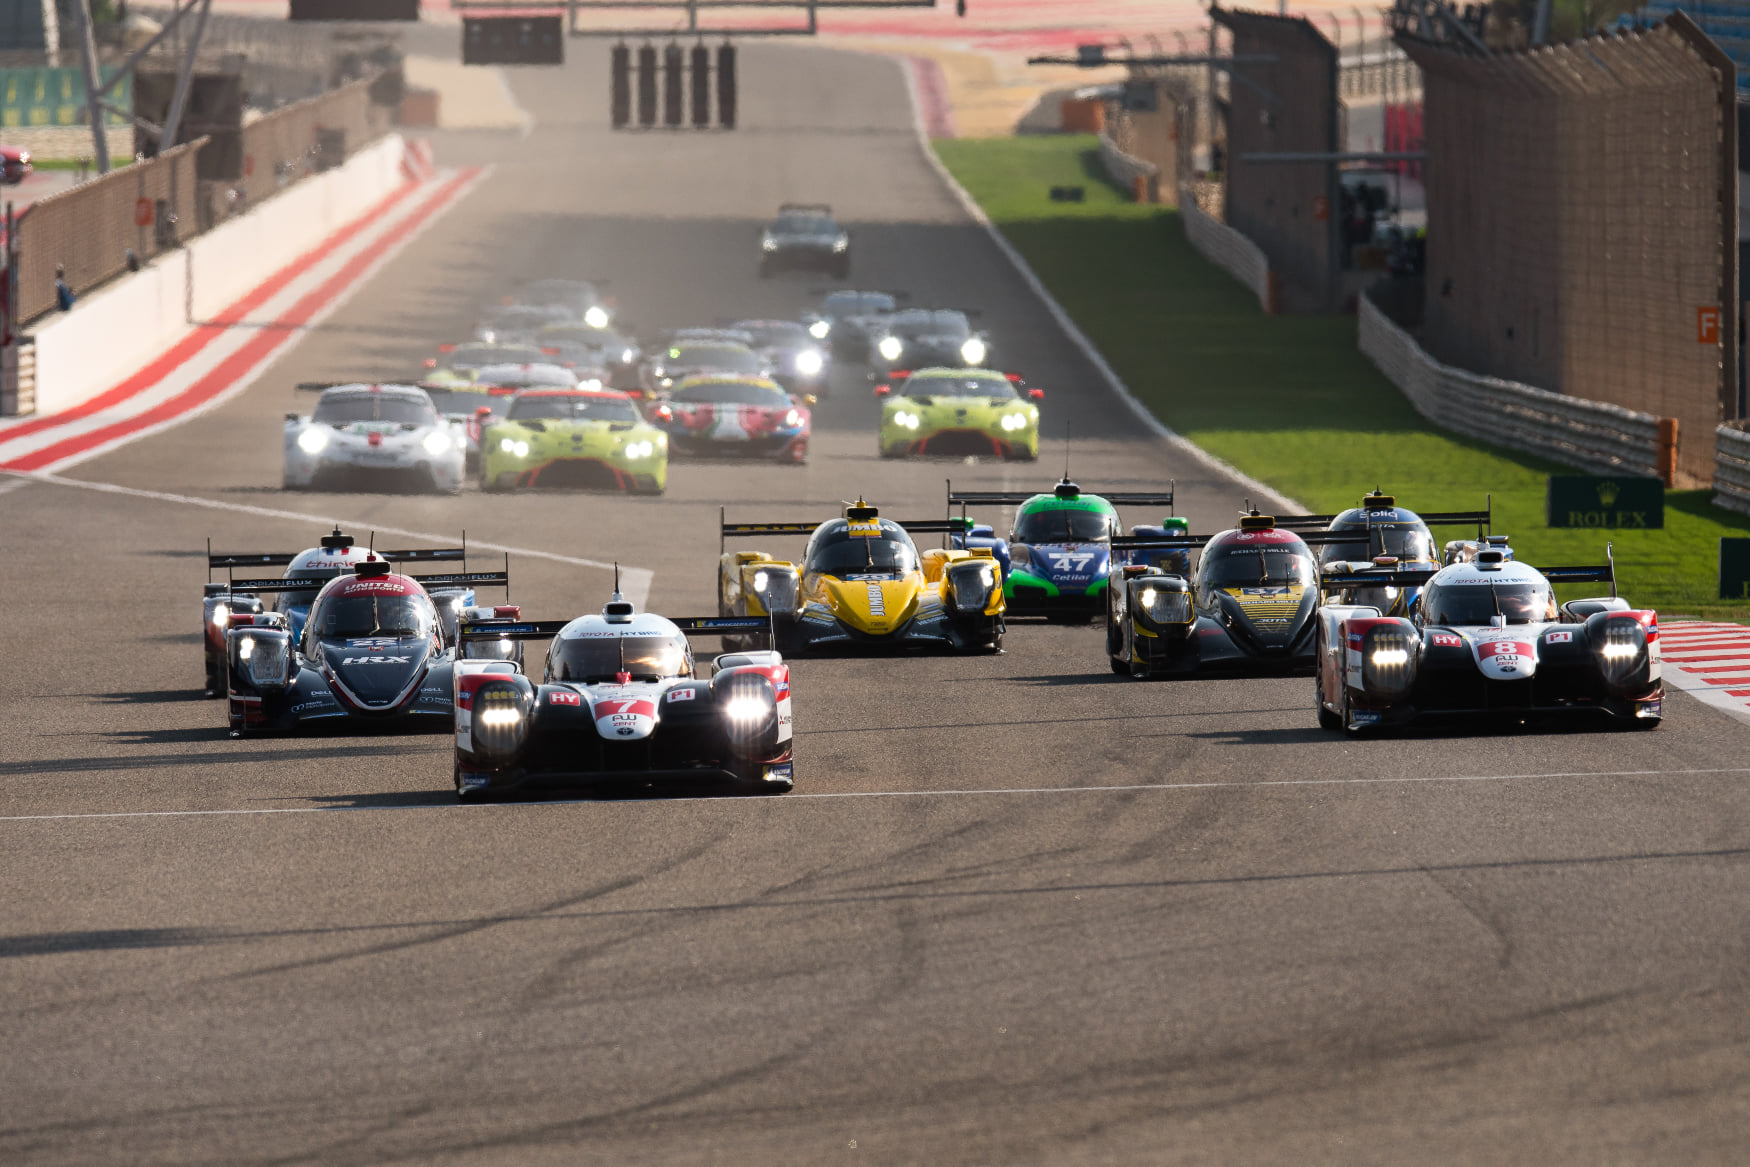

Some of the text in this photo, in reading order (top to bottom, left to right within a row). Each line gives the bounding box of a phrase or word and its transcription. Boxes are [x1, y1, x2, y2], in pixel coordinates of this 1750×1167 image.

[1701, 312, 1716, 338] F
[1568, 511, 1647, 528] ROLEX
[831, 524, 898, 535] JUMBO
[305, 559, 362, 569] thirie
[1053, 558, 1091, 571] 47
[344, 582, 406, 591] UNITED
[866, 584, 886, 617] JUMBO
[1434, 635, 1458, 645] HY
[1549, 632, 1569, 642] P1
[1494, 642, 1518, 654] 8
[342, 655, 413, 664] HRX
[551, 693, 578, 703] HY
[671, 689, 692, 700] P1
[612, 699, 638, 713] 7
